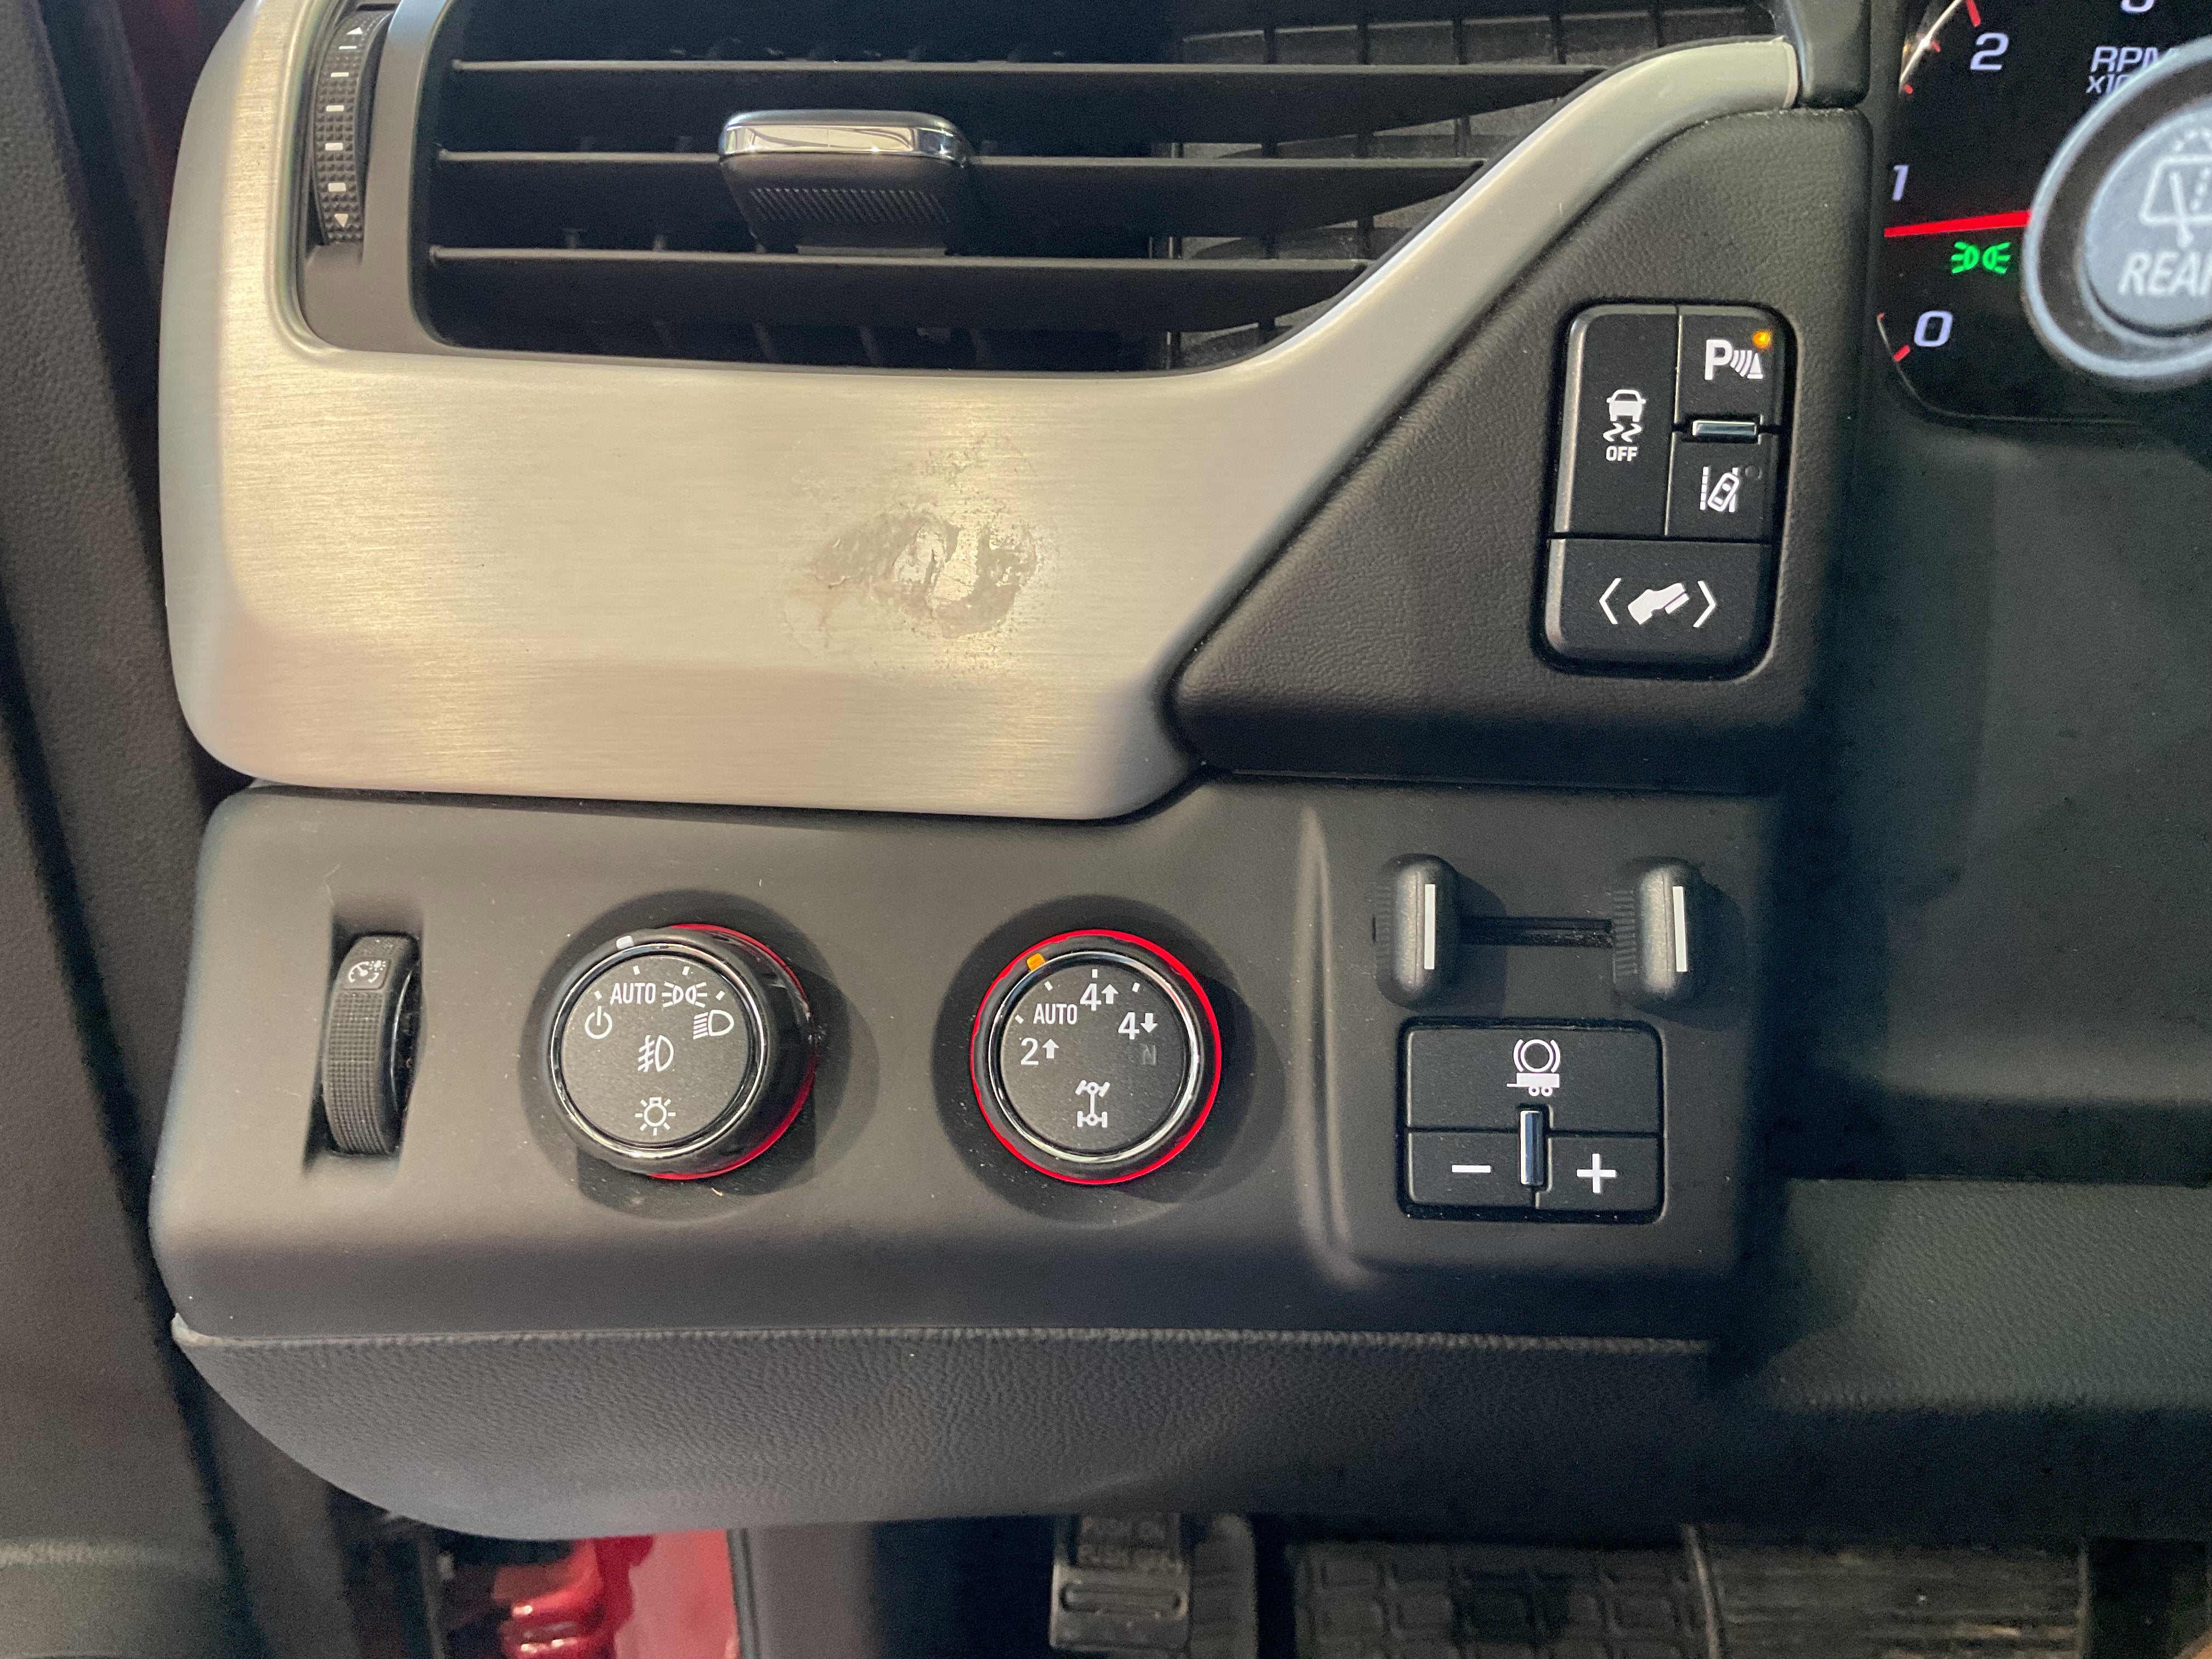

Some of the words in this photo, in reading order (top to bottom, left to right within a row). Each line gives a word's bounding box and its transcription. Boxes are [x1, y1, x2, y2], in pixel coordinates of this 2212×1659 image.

[1970, 32, 2009, 71] 2
[1892, 165, 1909, 201] 1
[1914, 311, 1953, 347] 0
[1704, 338, 1734, 380] P
[1605, 445, 1638, 462] OFF
[610, 981, 657, 1005] AUTO
[1080, 983, 1102, 1012] 4
[1032, 1002, 1078, 1025] AUTO
[1118, 1012, 1140, 1040] 4
[1020, 1036, 1040, 1066] 2
